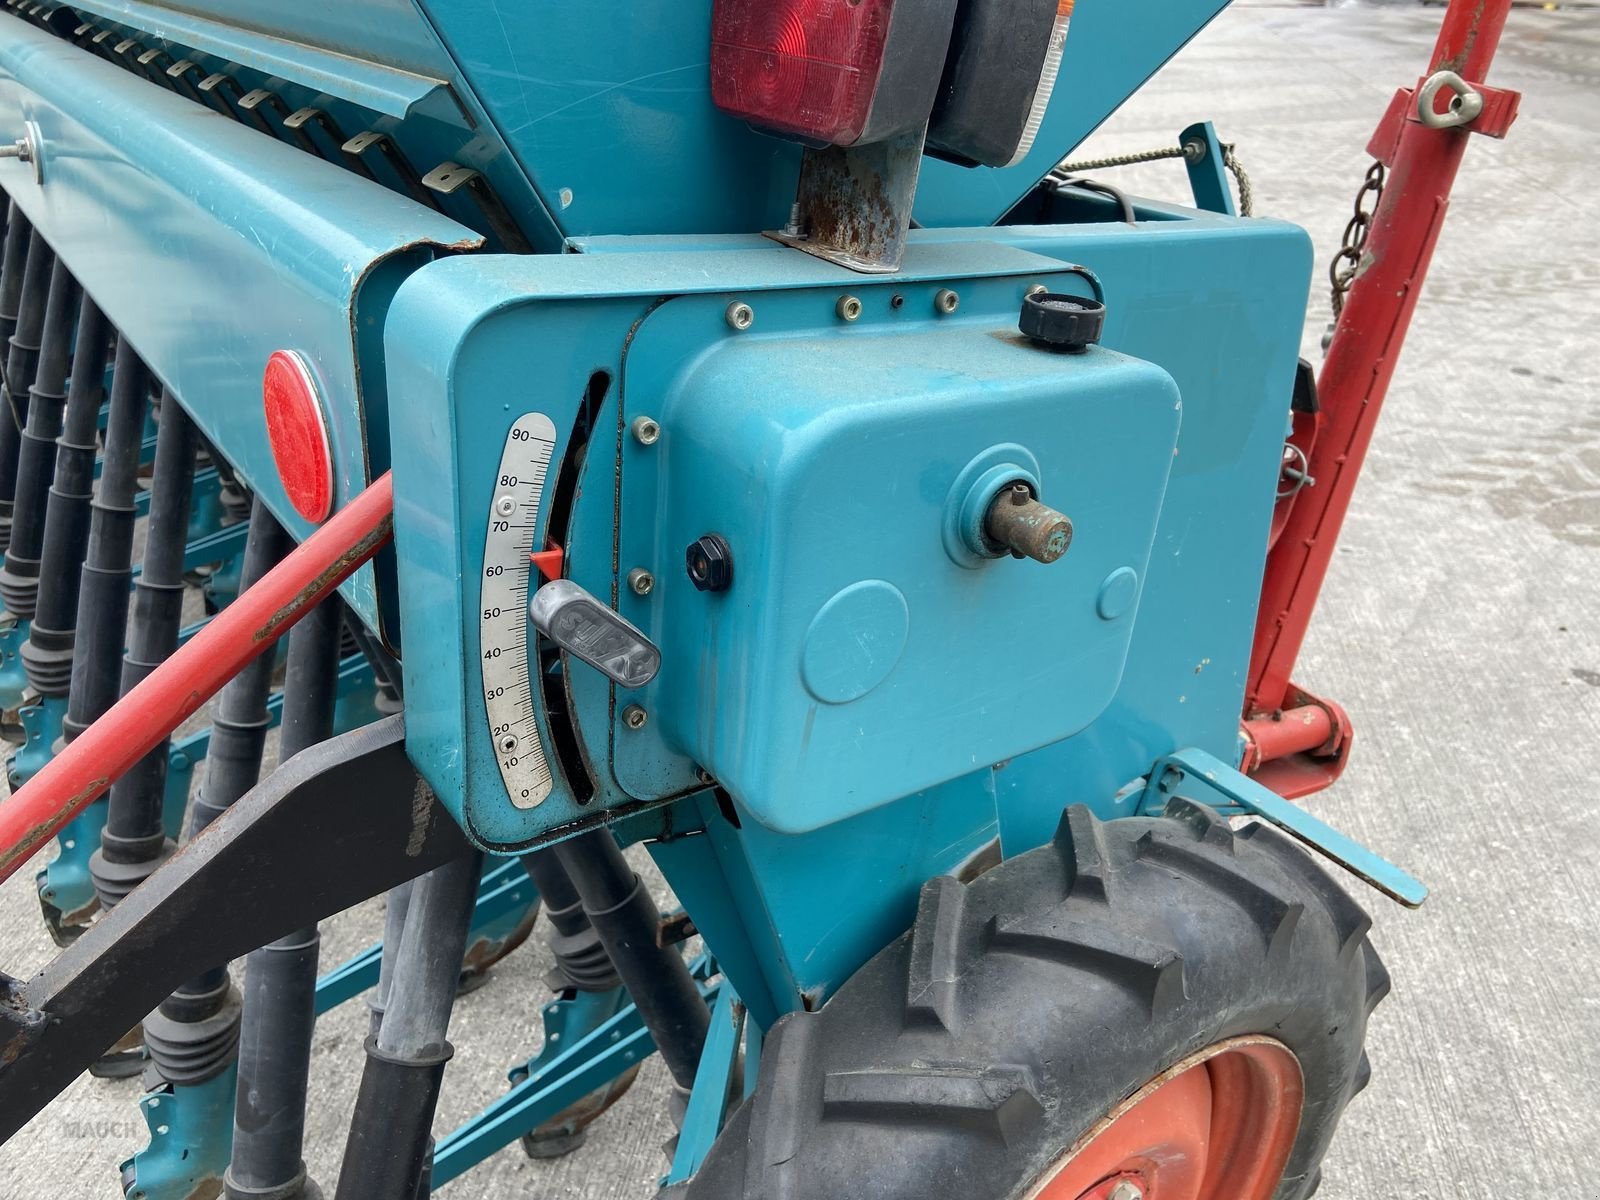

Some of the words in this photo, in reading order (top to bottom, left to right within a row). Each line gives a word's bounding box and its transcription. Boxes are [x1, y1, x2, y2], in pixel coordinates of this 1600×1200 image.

[512, 429, 529, 441] 90
[500, 476, 517, 487] 80
[493, 521, 509, 531] 70
[486, 566, 503, 577] 60
[484, 608, 500, 619] 50
[484, 648, 501, 659] 40
[487, 687, 504, 700] 30
[494, 724, 509, 736] 20
[504, 757, 518, 770] 10
[521, 789, 529, 798] 0
